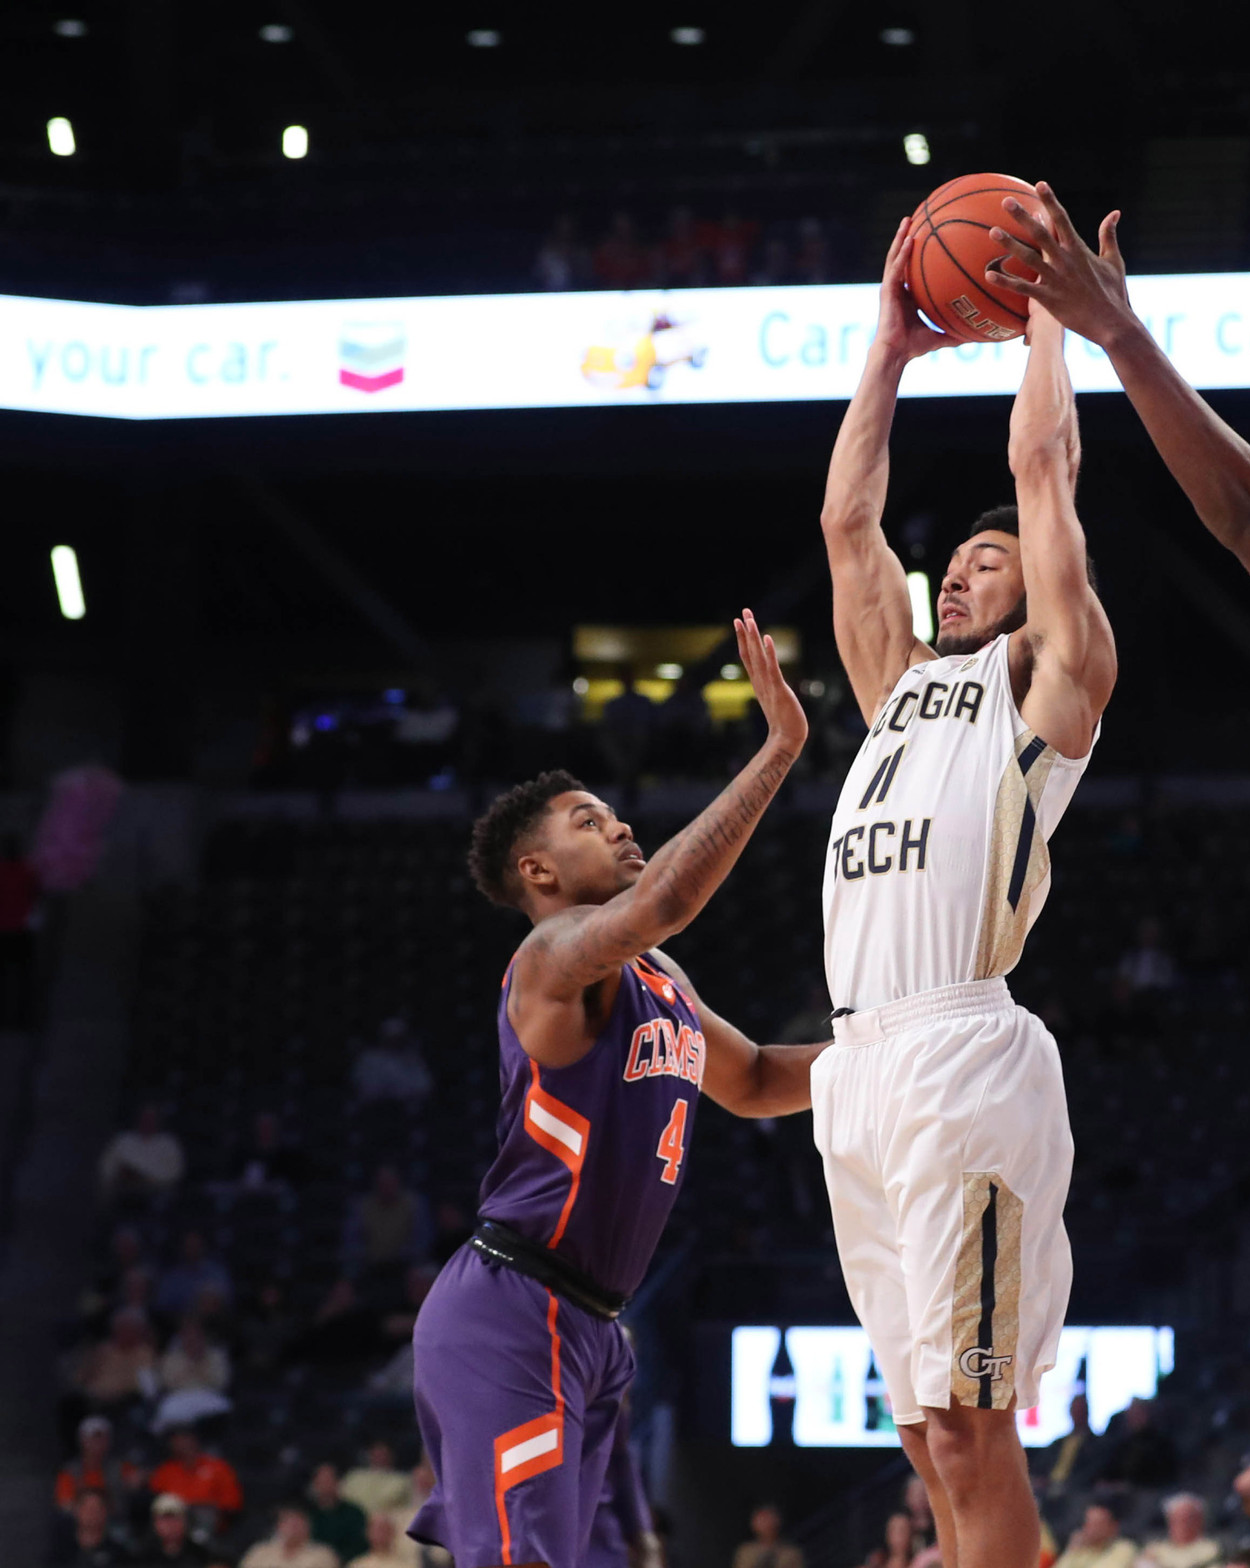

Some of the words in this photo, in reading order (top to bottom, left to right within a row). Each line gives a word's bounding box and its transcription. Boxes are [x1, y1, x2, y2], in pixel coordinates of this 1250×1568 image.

[950, 294, 1016, 339] ELITE
[25, 337, 162, 393] your
[183, 339, 291, 388] car.
[856, 741, 909, 812] 11
[832, 817, 933, 884] TECH
[656, 1098, 688, 1184] 4
